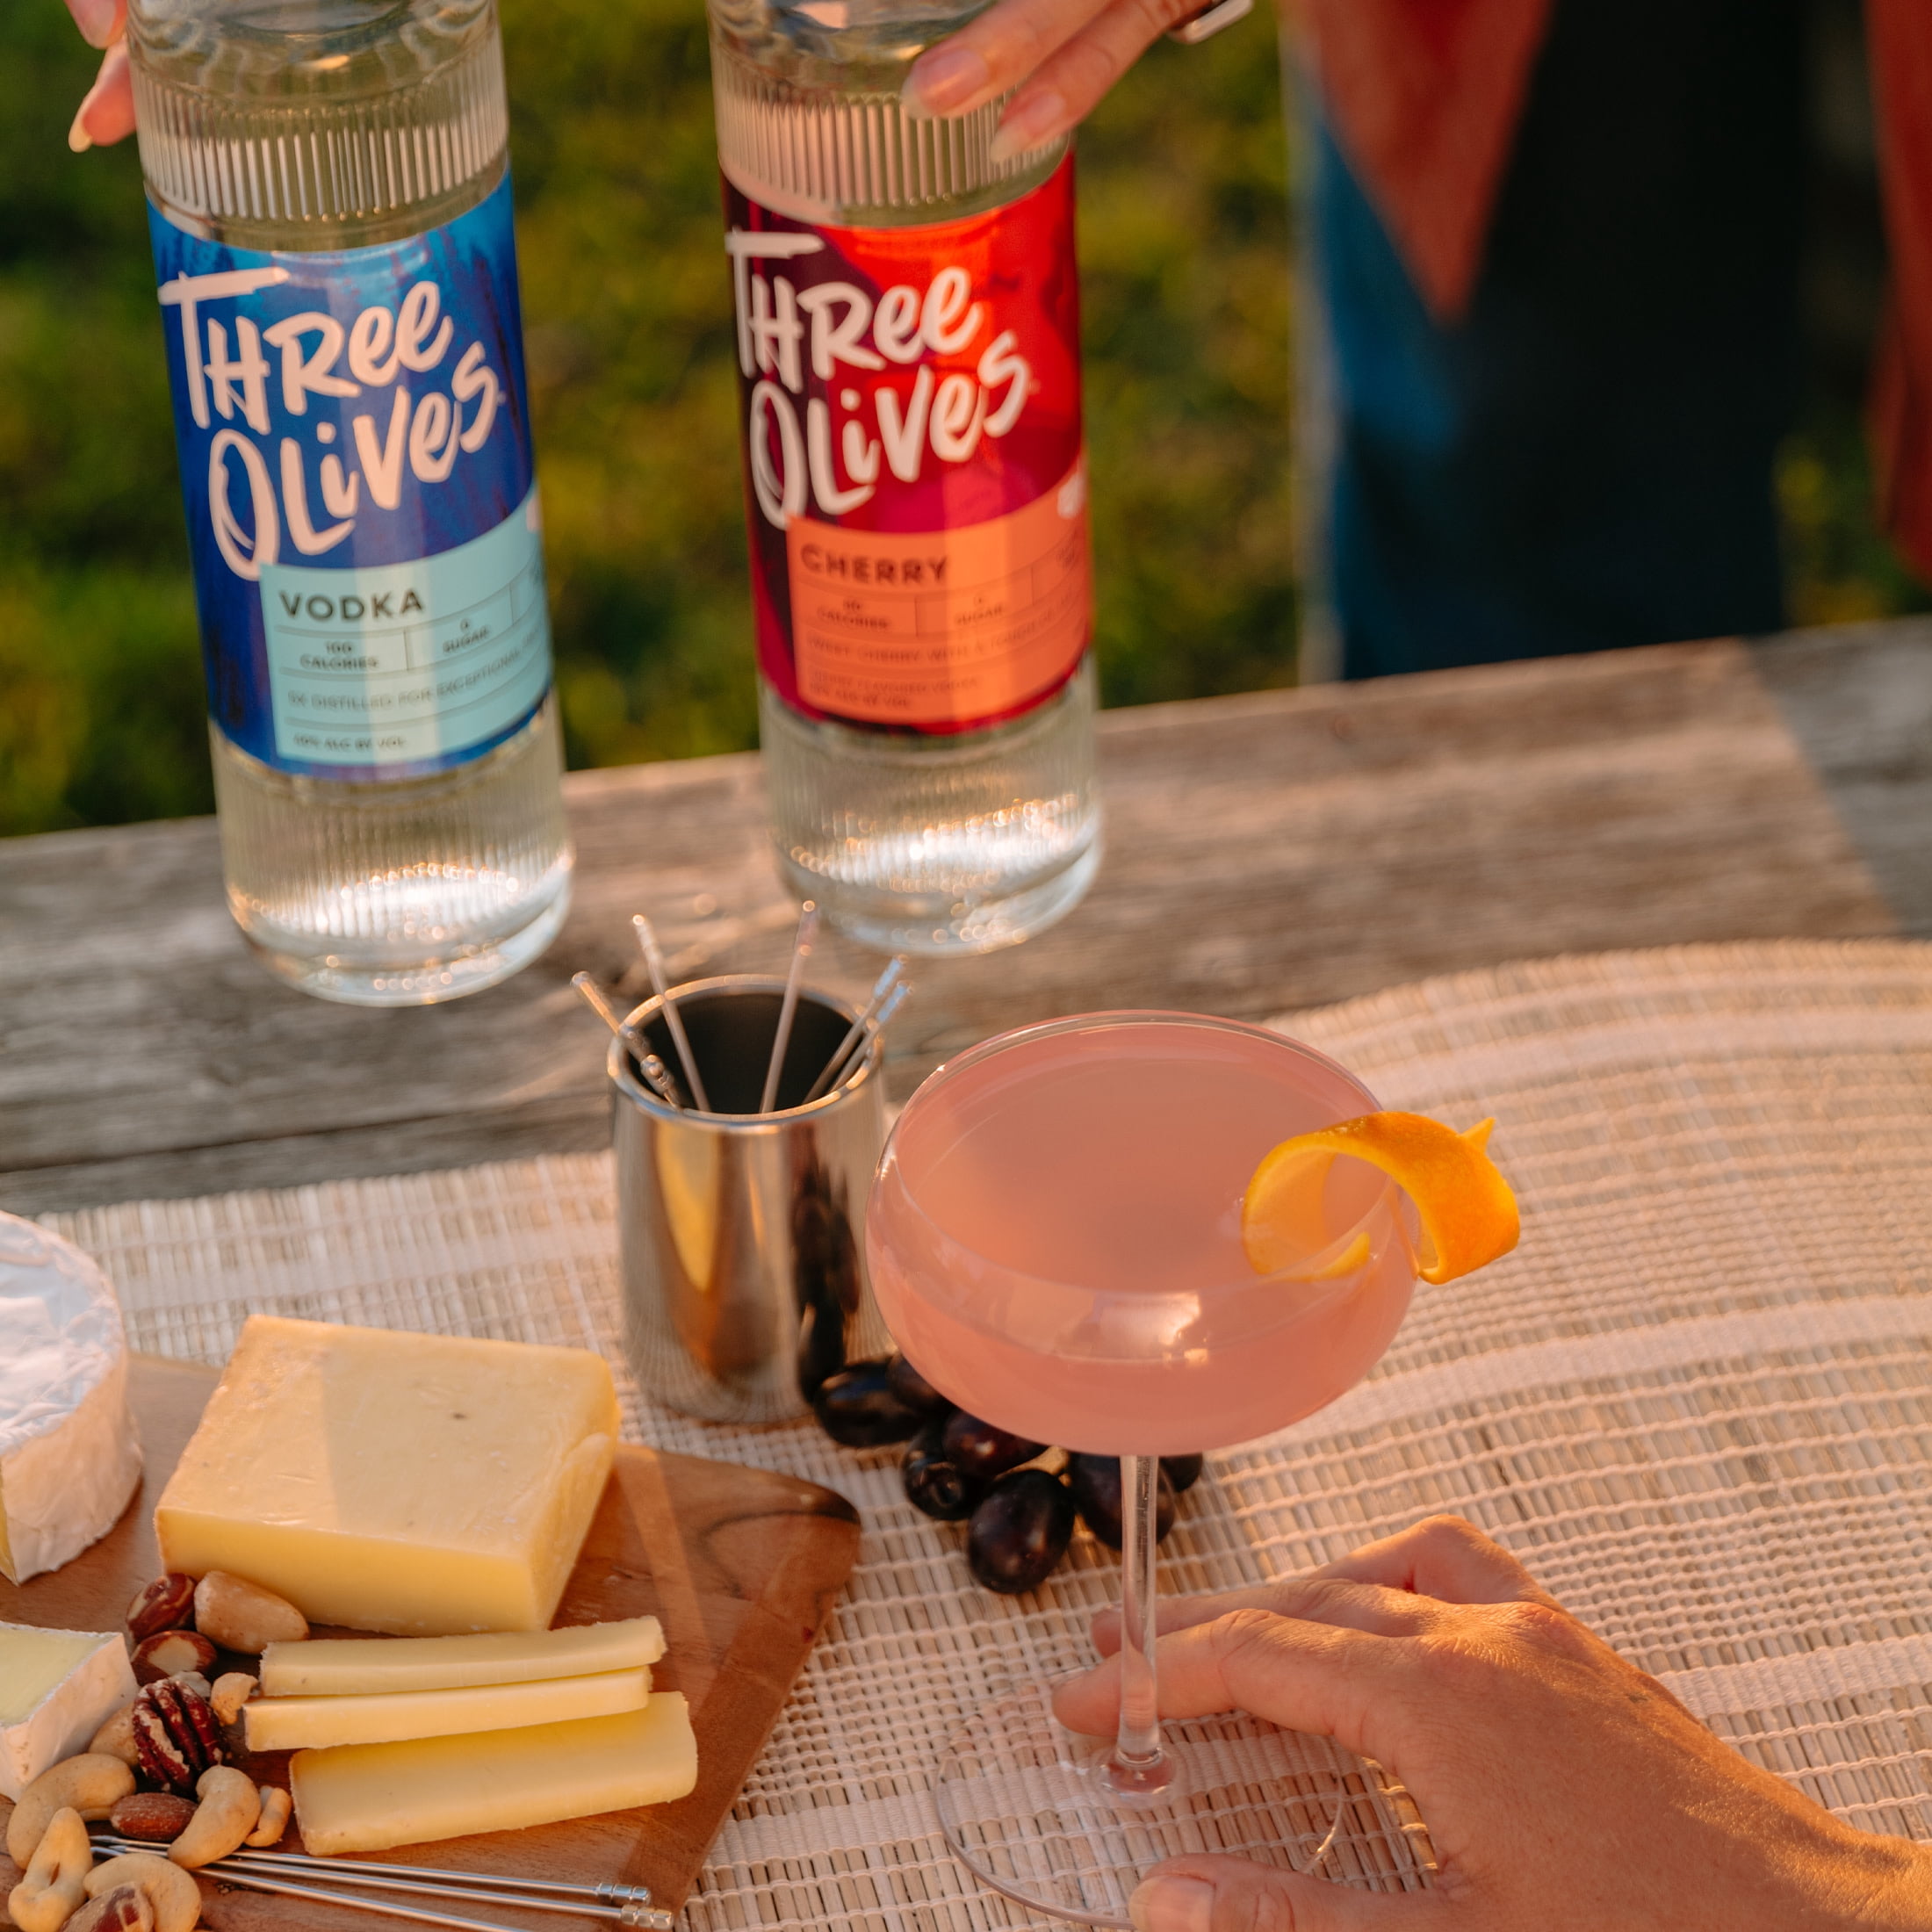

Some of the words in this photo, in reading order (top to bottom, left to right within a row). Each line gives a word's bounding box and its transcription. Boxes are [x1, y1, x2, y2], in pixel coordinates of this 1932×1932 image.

[799, 542, 948, 584] CHERRY
[278, 588, 424, 622] VODKA
[443, 624, 489, 653] SUGAR
[299, 652, 378, 671] CALORIES
